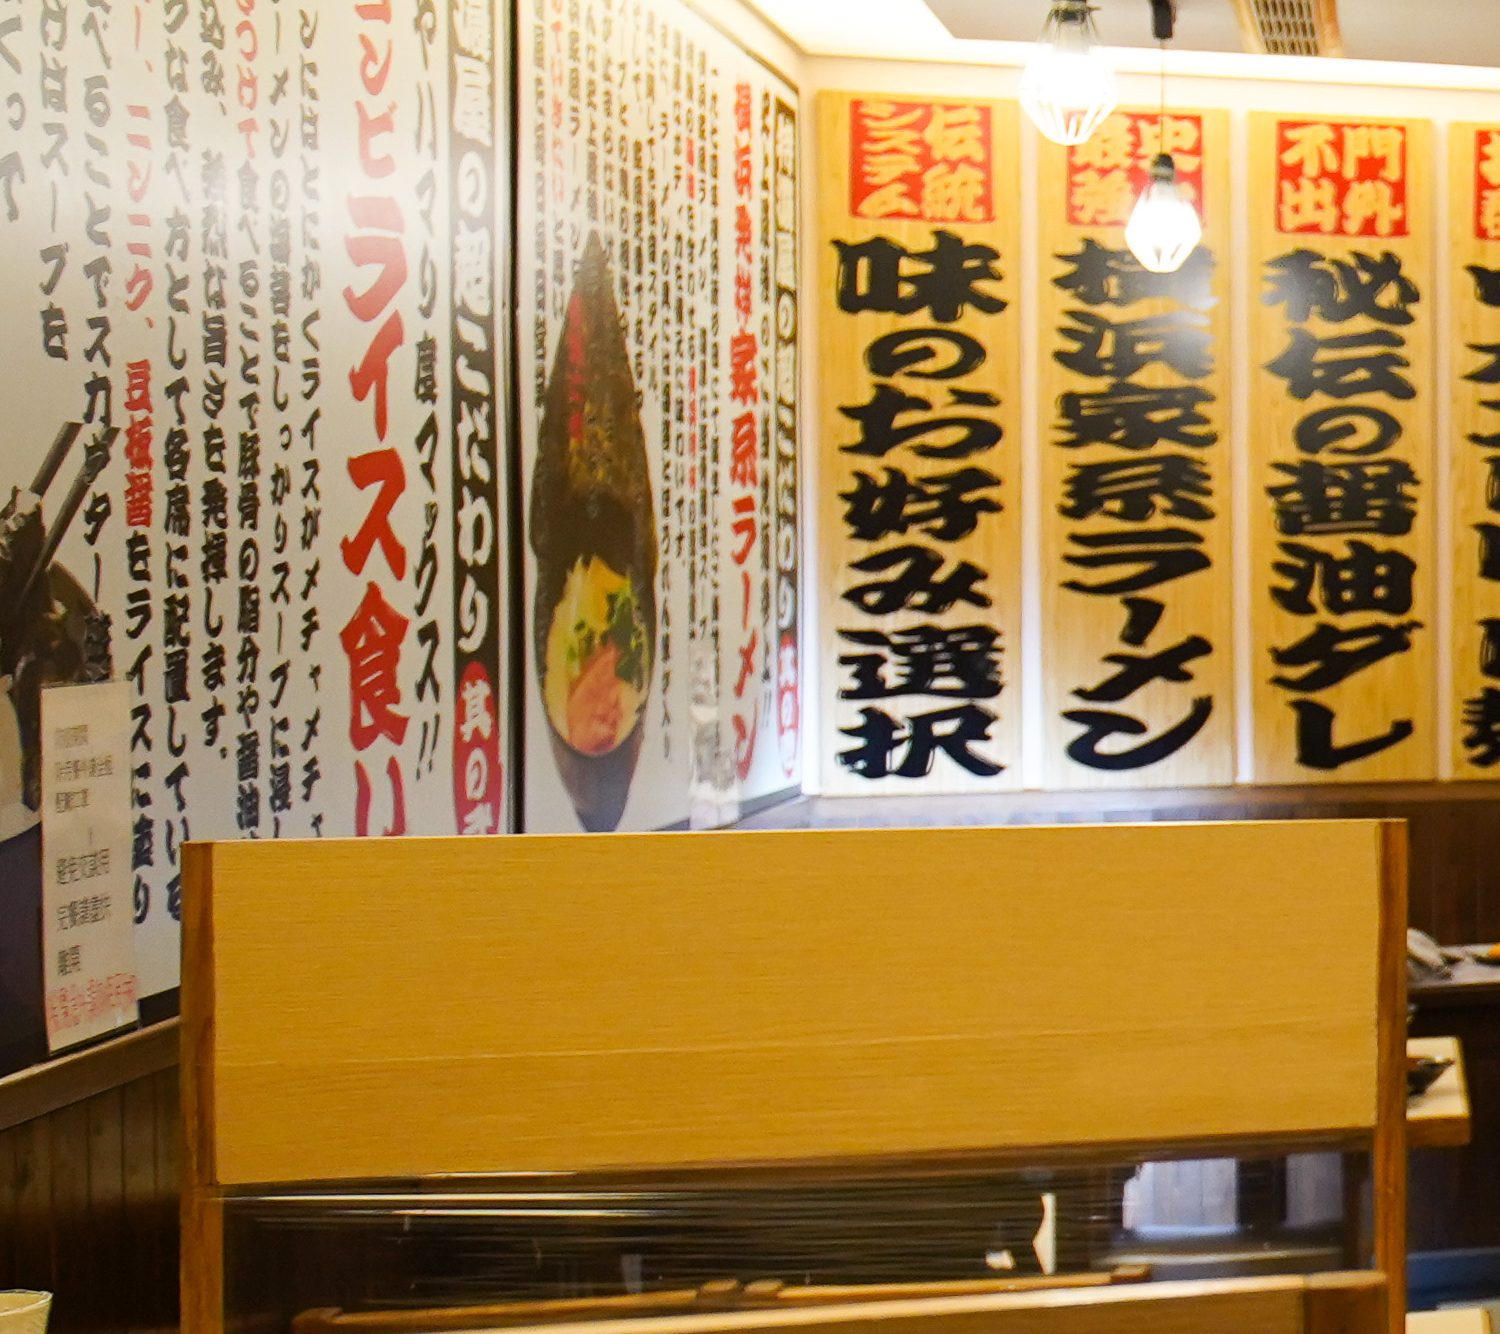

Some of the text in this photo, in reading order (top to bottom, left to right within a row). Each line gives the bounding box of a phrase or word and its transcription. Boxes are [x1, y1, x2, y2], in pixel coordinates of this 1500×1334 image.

[920, 104, 990, 223] 伝統
[1281, 124, 1404, 236] 門外 不出
[829, 228, 1011, 780] 味のお好み選択
[1051, 237, 1219, 772] 横浜家系ラーメン
